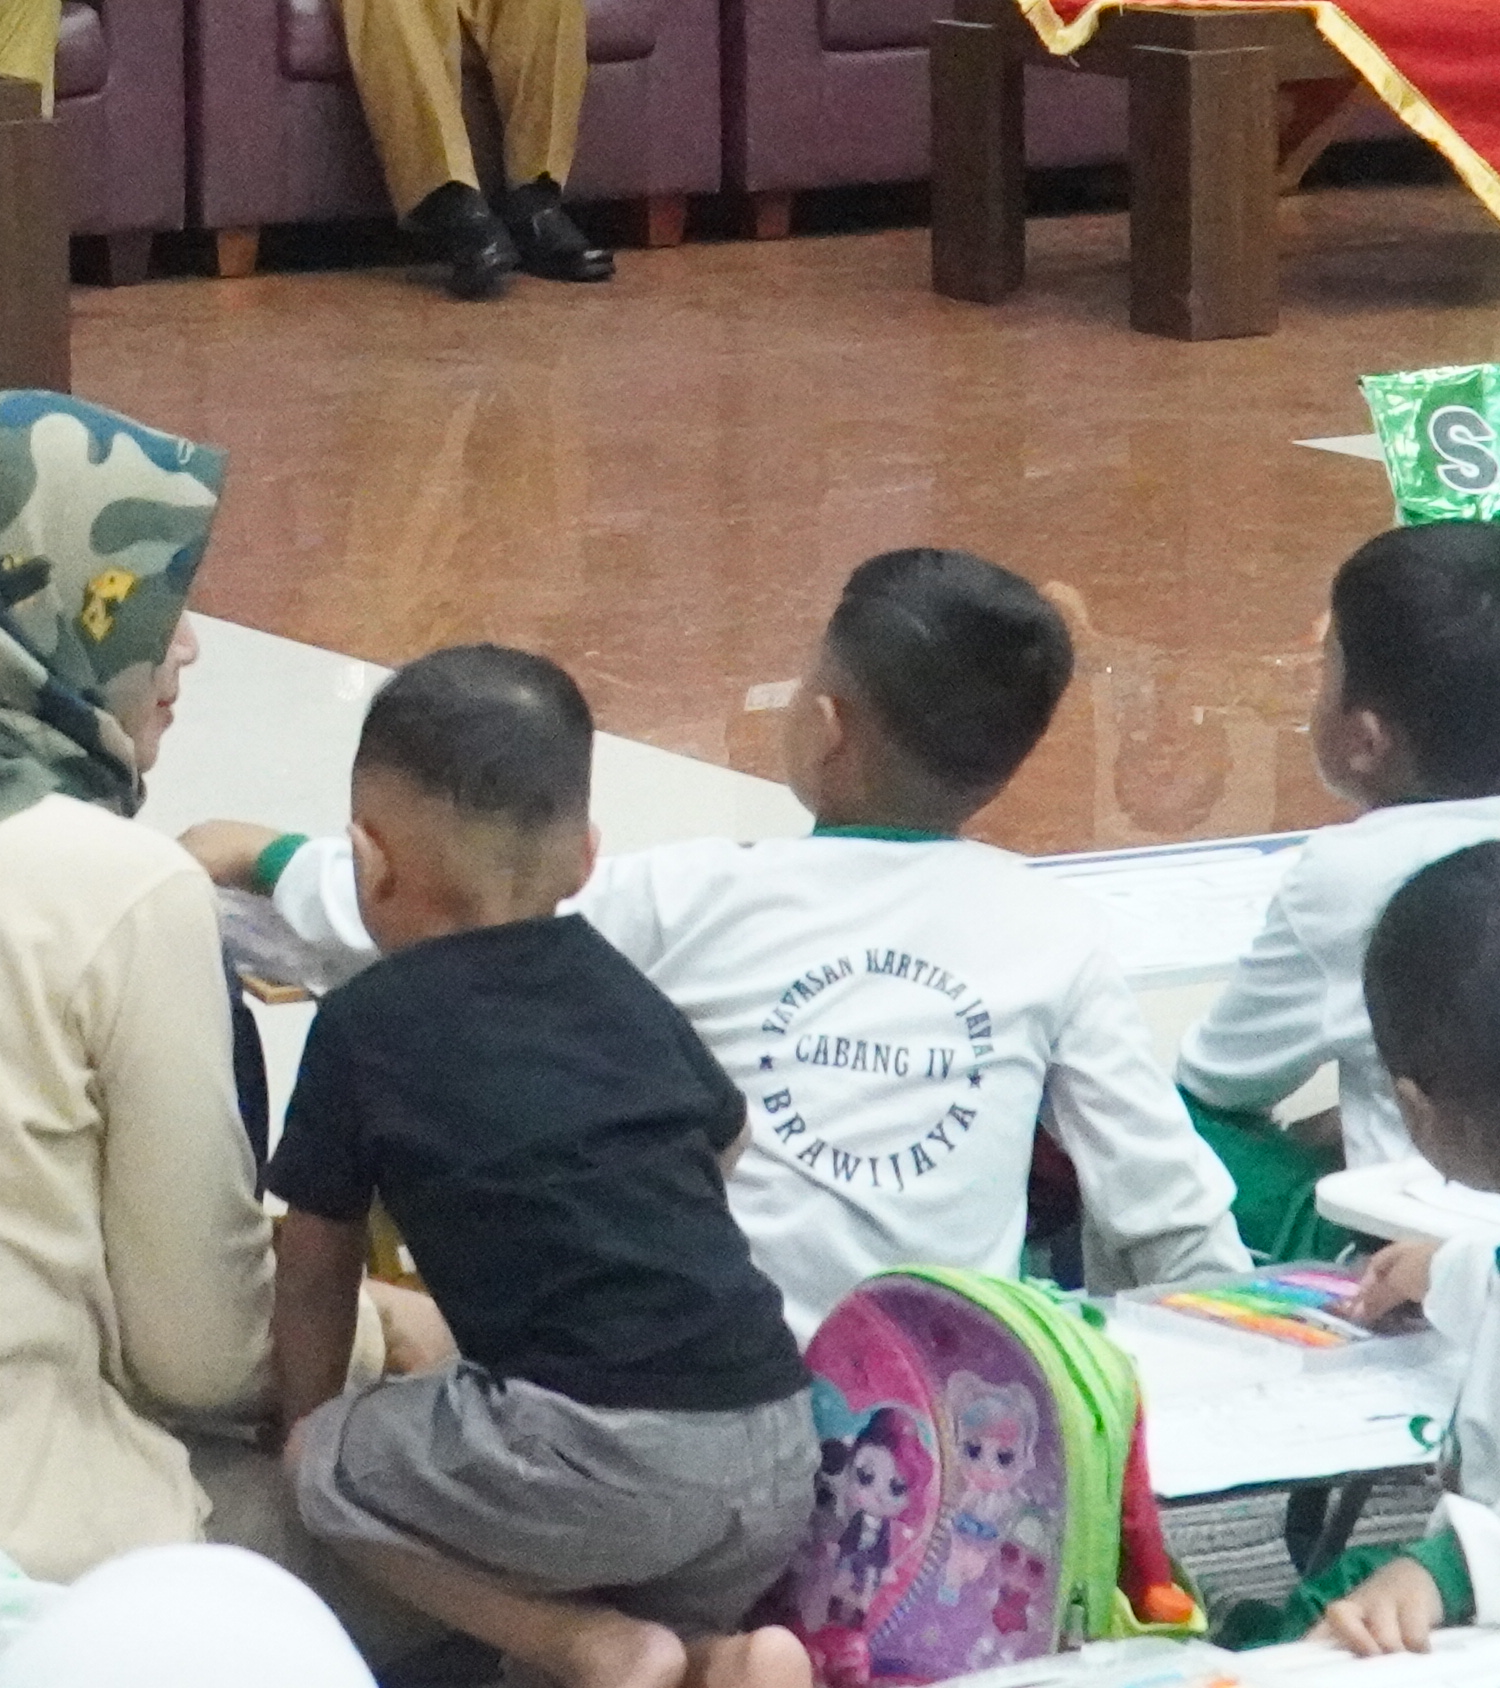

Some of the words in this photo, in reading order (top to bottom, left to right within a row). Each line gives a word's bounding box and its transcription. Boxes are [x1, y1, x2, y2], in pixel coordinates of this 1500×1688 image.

[762, 955, 854, 1035] YAYASAN
[865, 948, 967, 1000] KARTIKA
[955, 998, 994, 1058] JAYA
[795, 1034, 909, 1077] CABANG
[925, 1047, 955, 1079] IV
[762, 1087, 977, 1191] BRAWIJAYA
